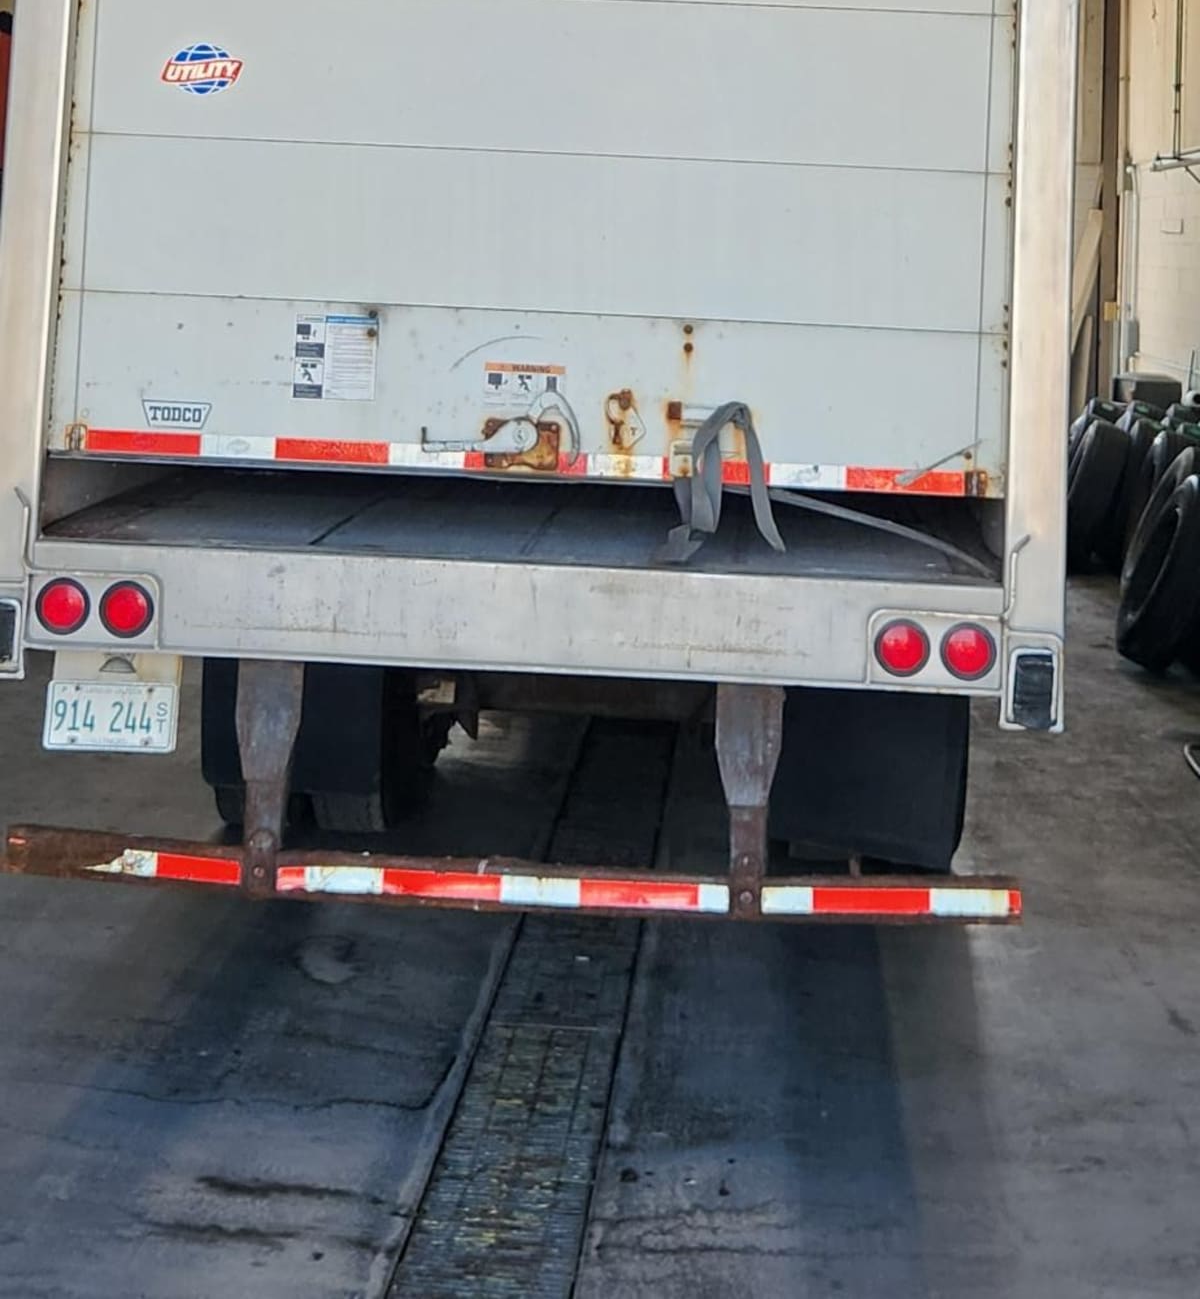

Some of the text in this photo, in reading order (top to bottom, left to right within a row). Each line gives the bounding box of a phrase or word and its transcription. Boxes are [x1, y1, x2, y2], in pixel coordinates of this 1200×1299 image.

[164, 61, 238, 81] UTILITY
[149, 405, 202, 423] TODCO
[54, 699, 152, 735] 914 244
